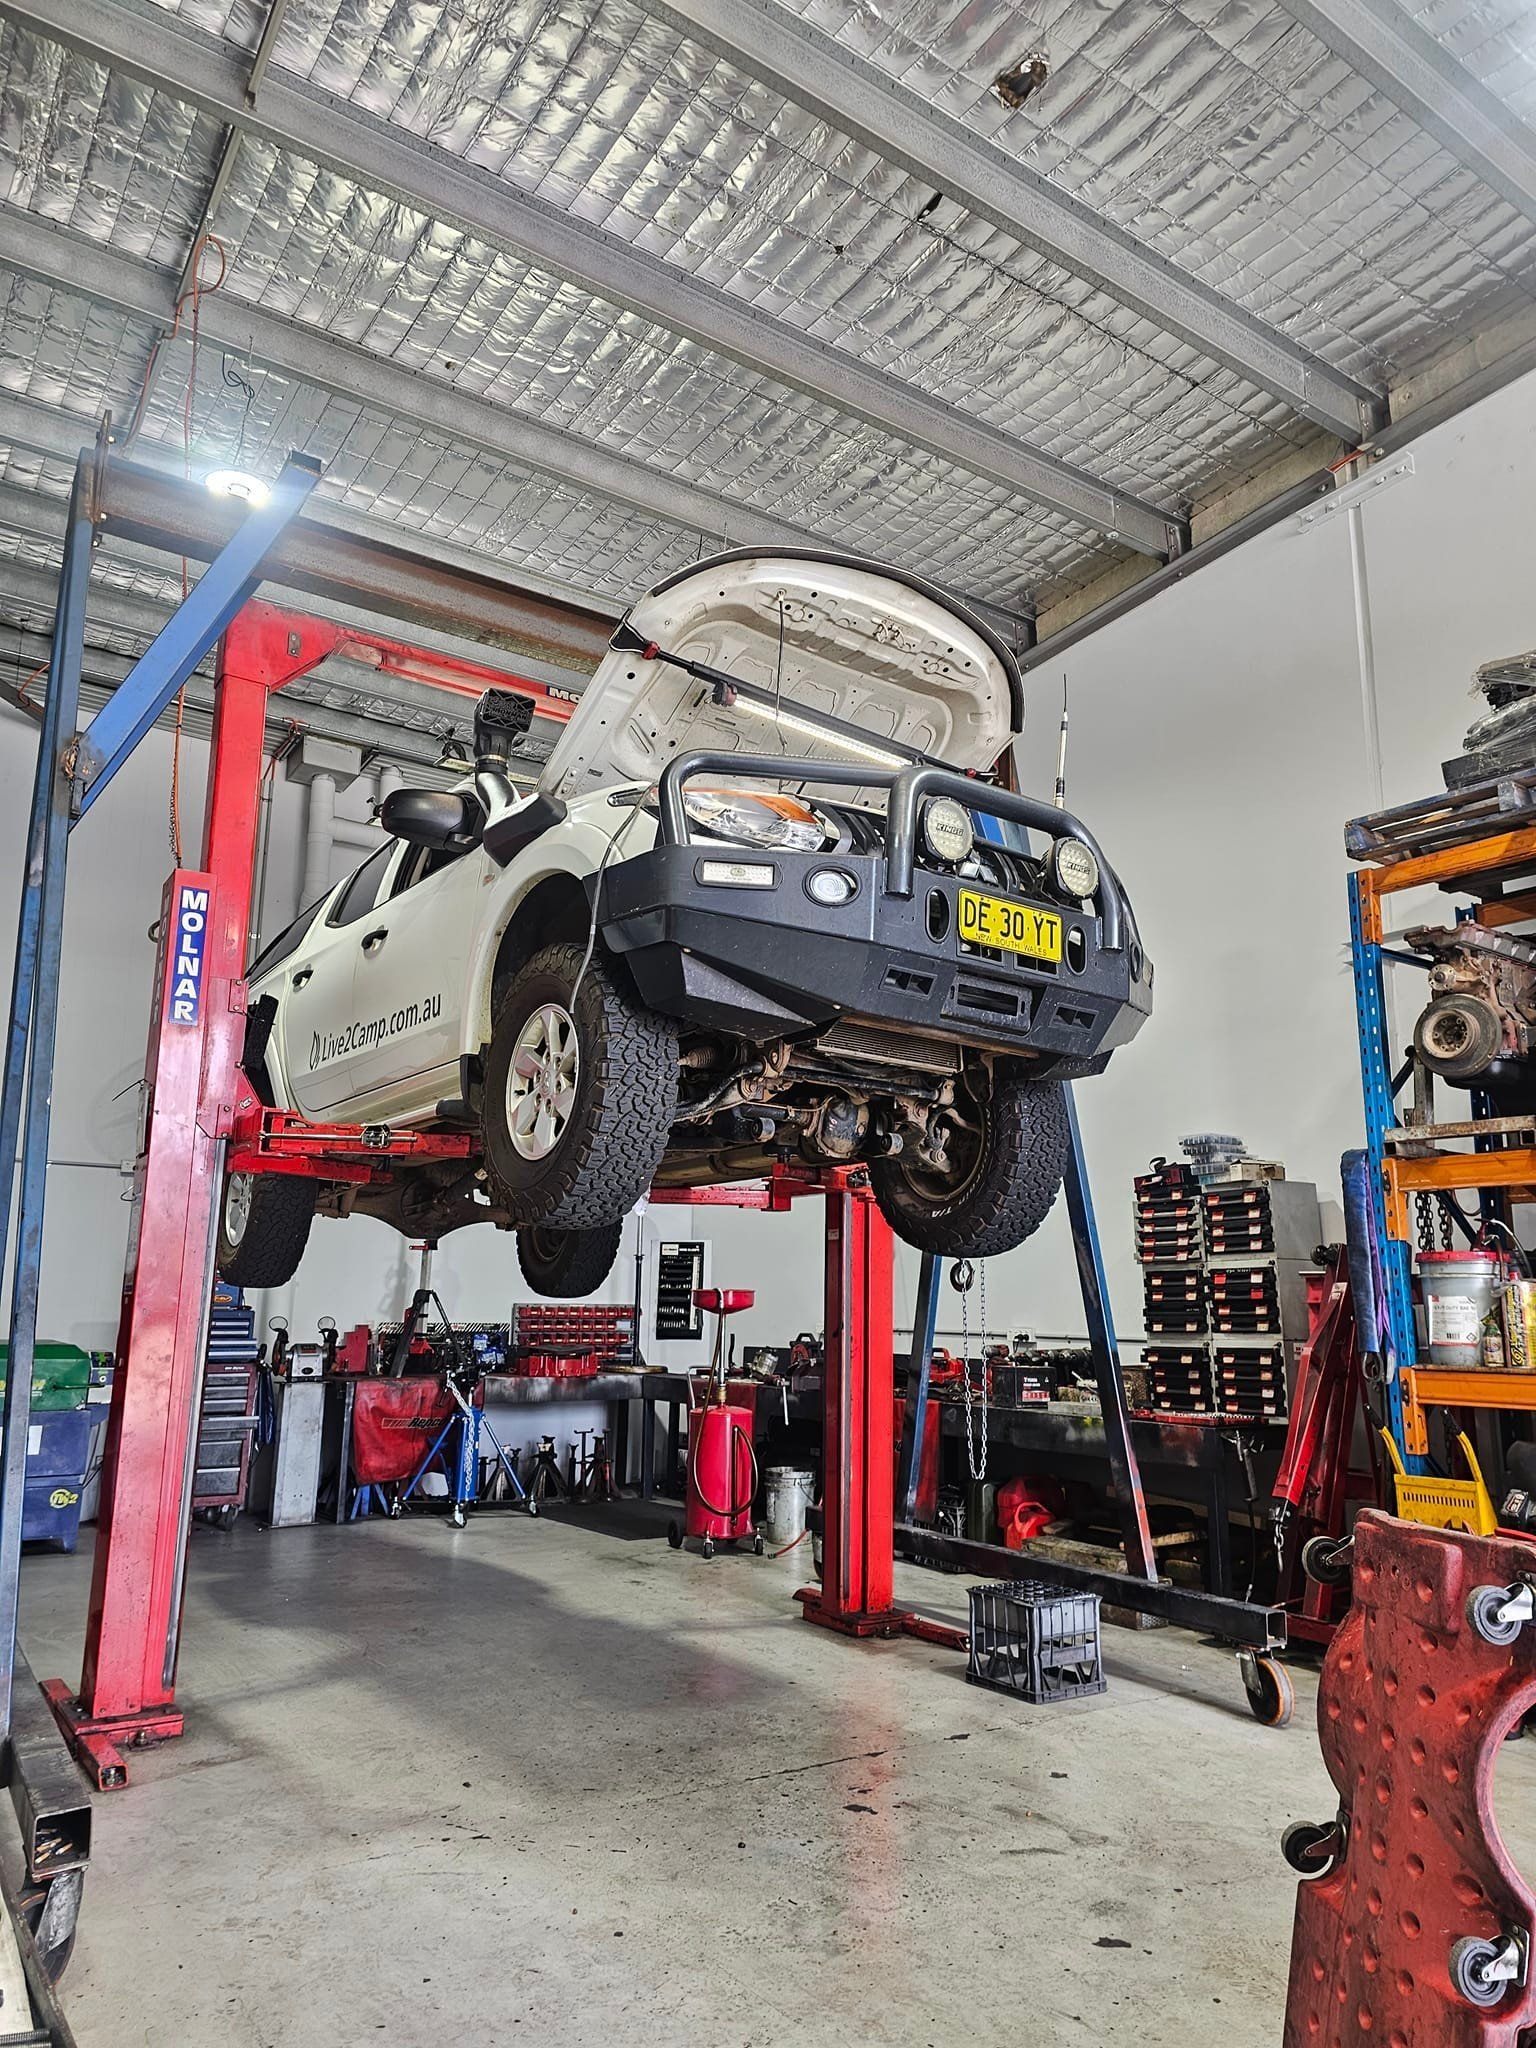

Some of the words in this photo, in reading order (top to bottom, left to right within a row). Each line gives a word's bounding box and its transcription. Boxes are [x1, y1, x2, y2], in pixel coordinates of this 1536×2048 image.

[964, 897, 991, 934] DE
[1000, 908, 1025, 941] 30
[1033, 915, 1058, 950] YT
[974, 932, 992, 943] NEW
[995, 936, 1020, 949] SOUTH
[1024, 944, 1048, 957] WALES
[173, 889, 208, 1021] MOLNAR
[321, 993, 441, 1062] Live2Camp.com.au
